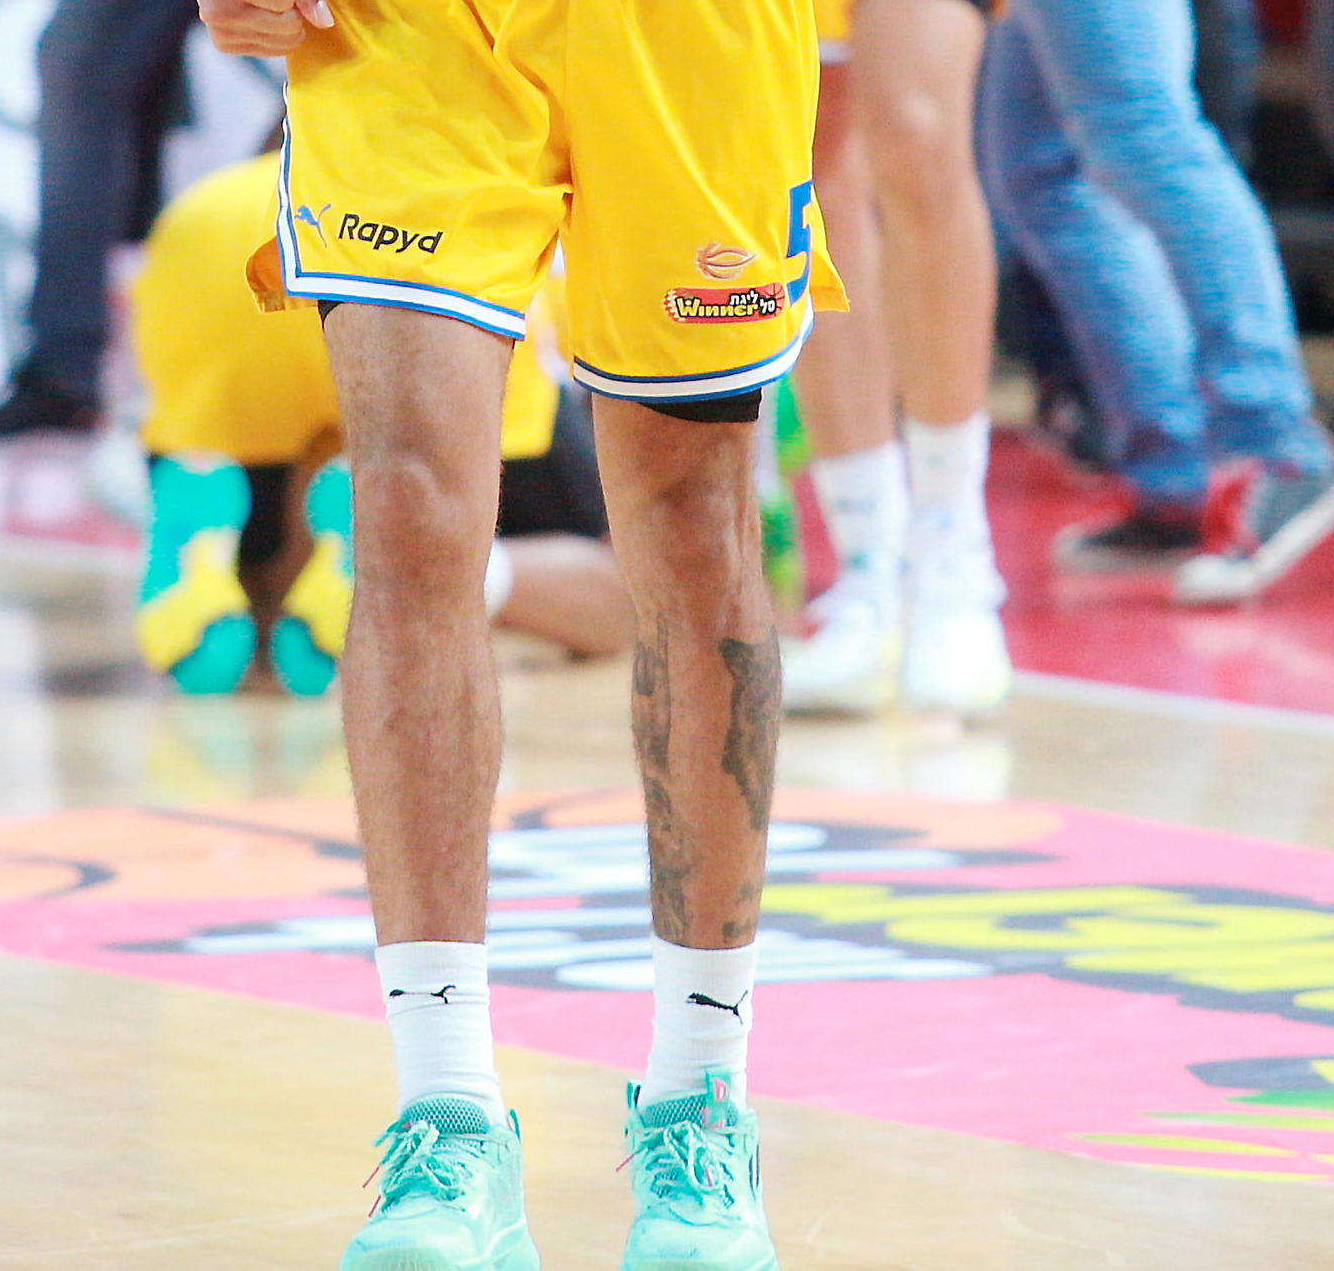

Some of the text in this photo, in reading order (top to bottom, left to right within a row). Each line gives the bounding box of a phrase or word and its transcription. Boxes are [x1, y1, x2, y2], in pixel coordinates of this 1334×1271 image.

[338, 212, 444, 254] Rapyd
[729, 290, 759, 305] ליגת
[759, 297, 776, 314] סל
[676, 297, 759, 317] Winner
